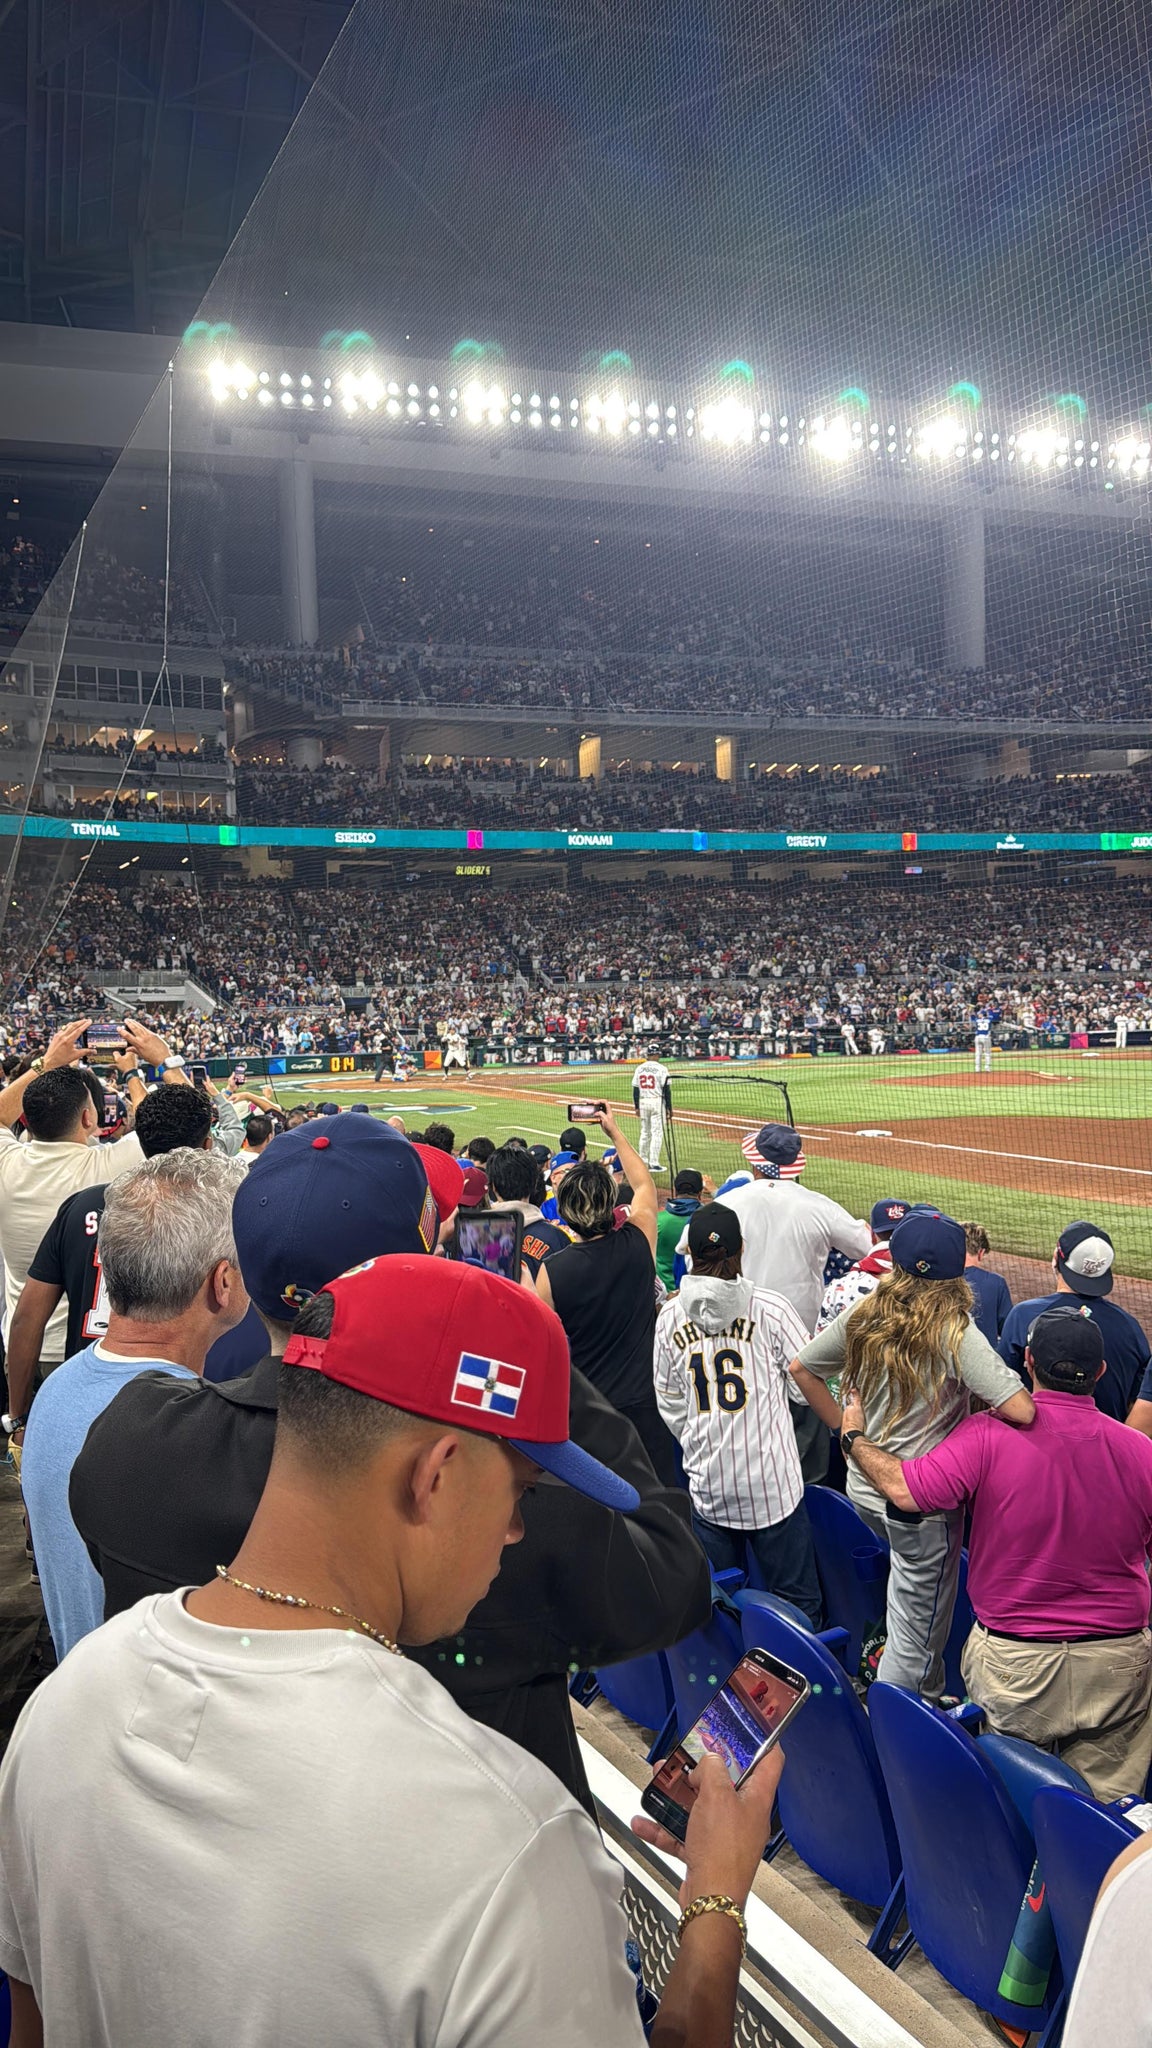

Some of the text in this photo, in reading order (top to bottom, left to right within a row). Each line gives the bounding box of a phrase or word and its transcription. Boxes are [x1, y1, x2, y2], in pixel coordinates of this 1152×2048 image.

[71, 822, 121, 837] TENTIAL
[334, 831, 376, 844] SEIKO
[568, 834, 613, 846] KONAMI
[1130, 836, 1152, 848] JUD
[639, 1074, 656, 1090] 23
[672, 1317, 757, 1350] OHNI
[687, 1348, 749, 1413] 16
[861, 1635, 886, 1658] WORLD
